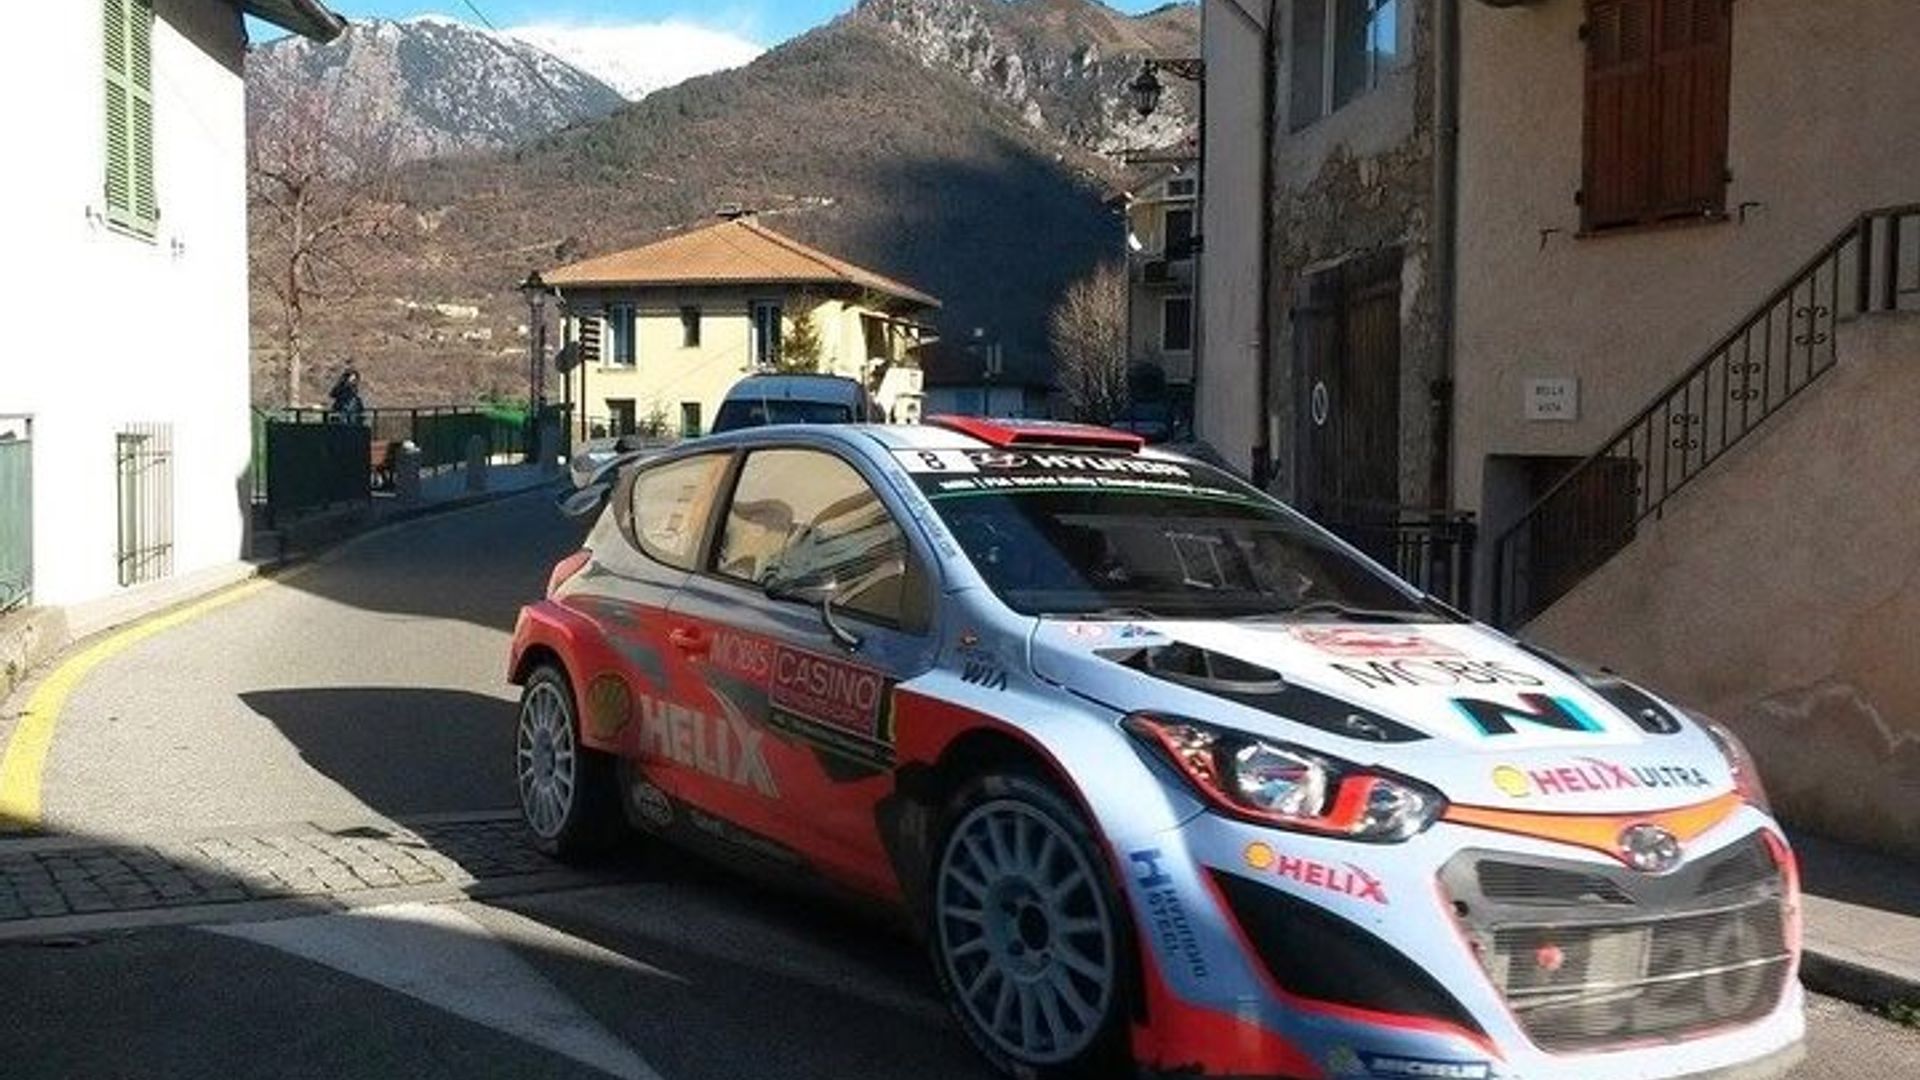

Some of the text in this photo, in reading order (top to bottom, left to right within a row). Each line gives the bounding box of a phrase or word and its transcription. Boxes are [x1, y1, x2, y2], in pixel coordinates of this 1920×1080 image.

[917, 451, 947, 470] 8
[1031, 454, 1191, 478] HYUNDAI
[777, 652, 878, 710] CASINO
[1330, 659, 1545, 690] MOBIS
[639, 686, 780, 799] HELIX
[1528, 757, 1711, 796] HELIX ULTRA
[1278, 854, 1390, 905] HELIX
